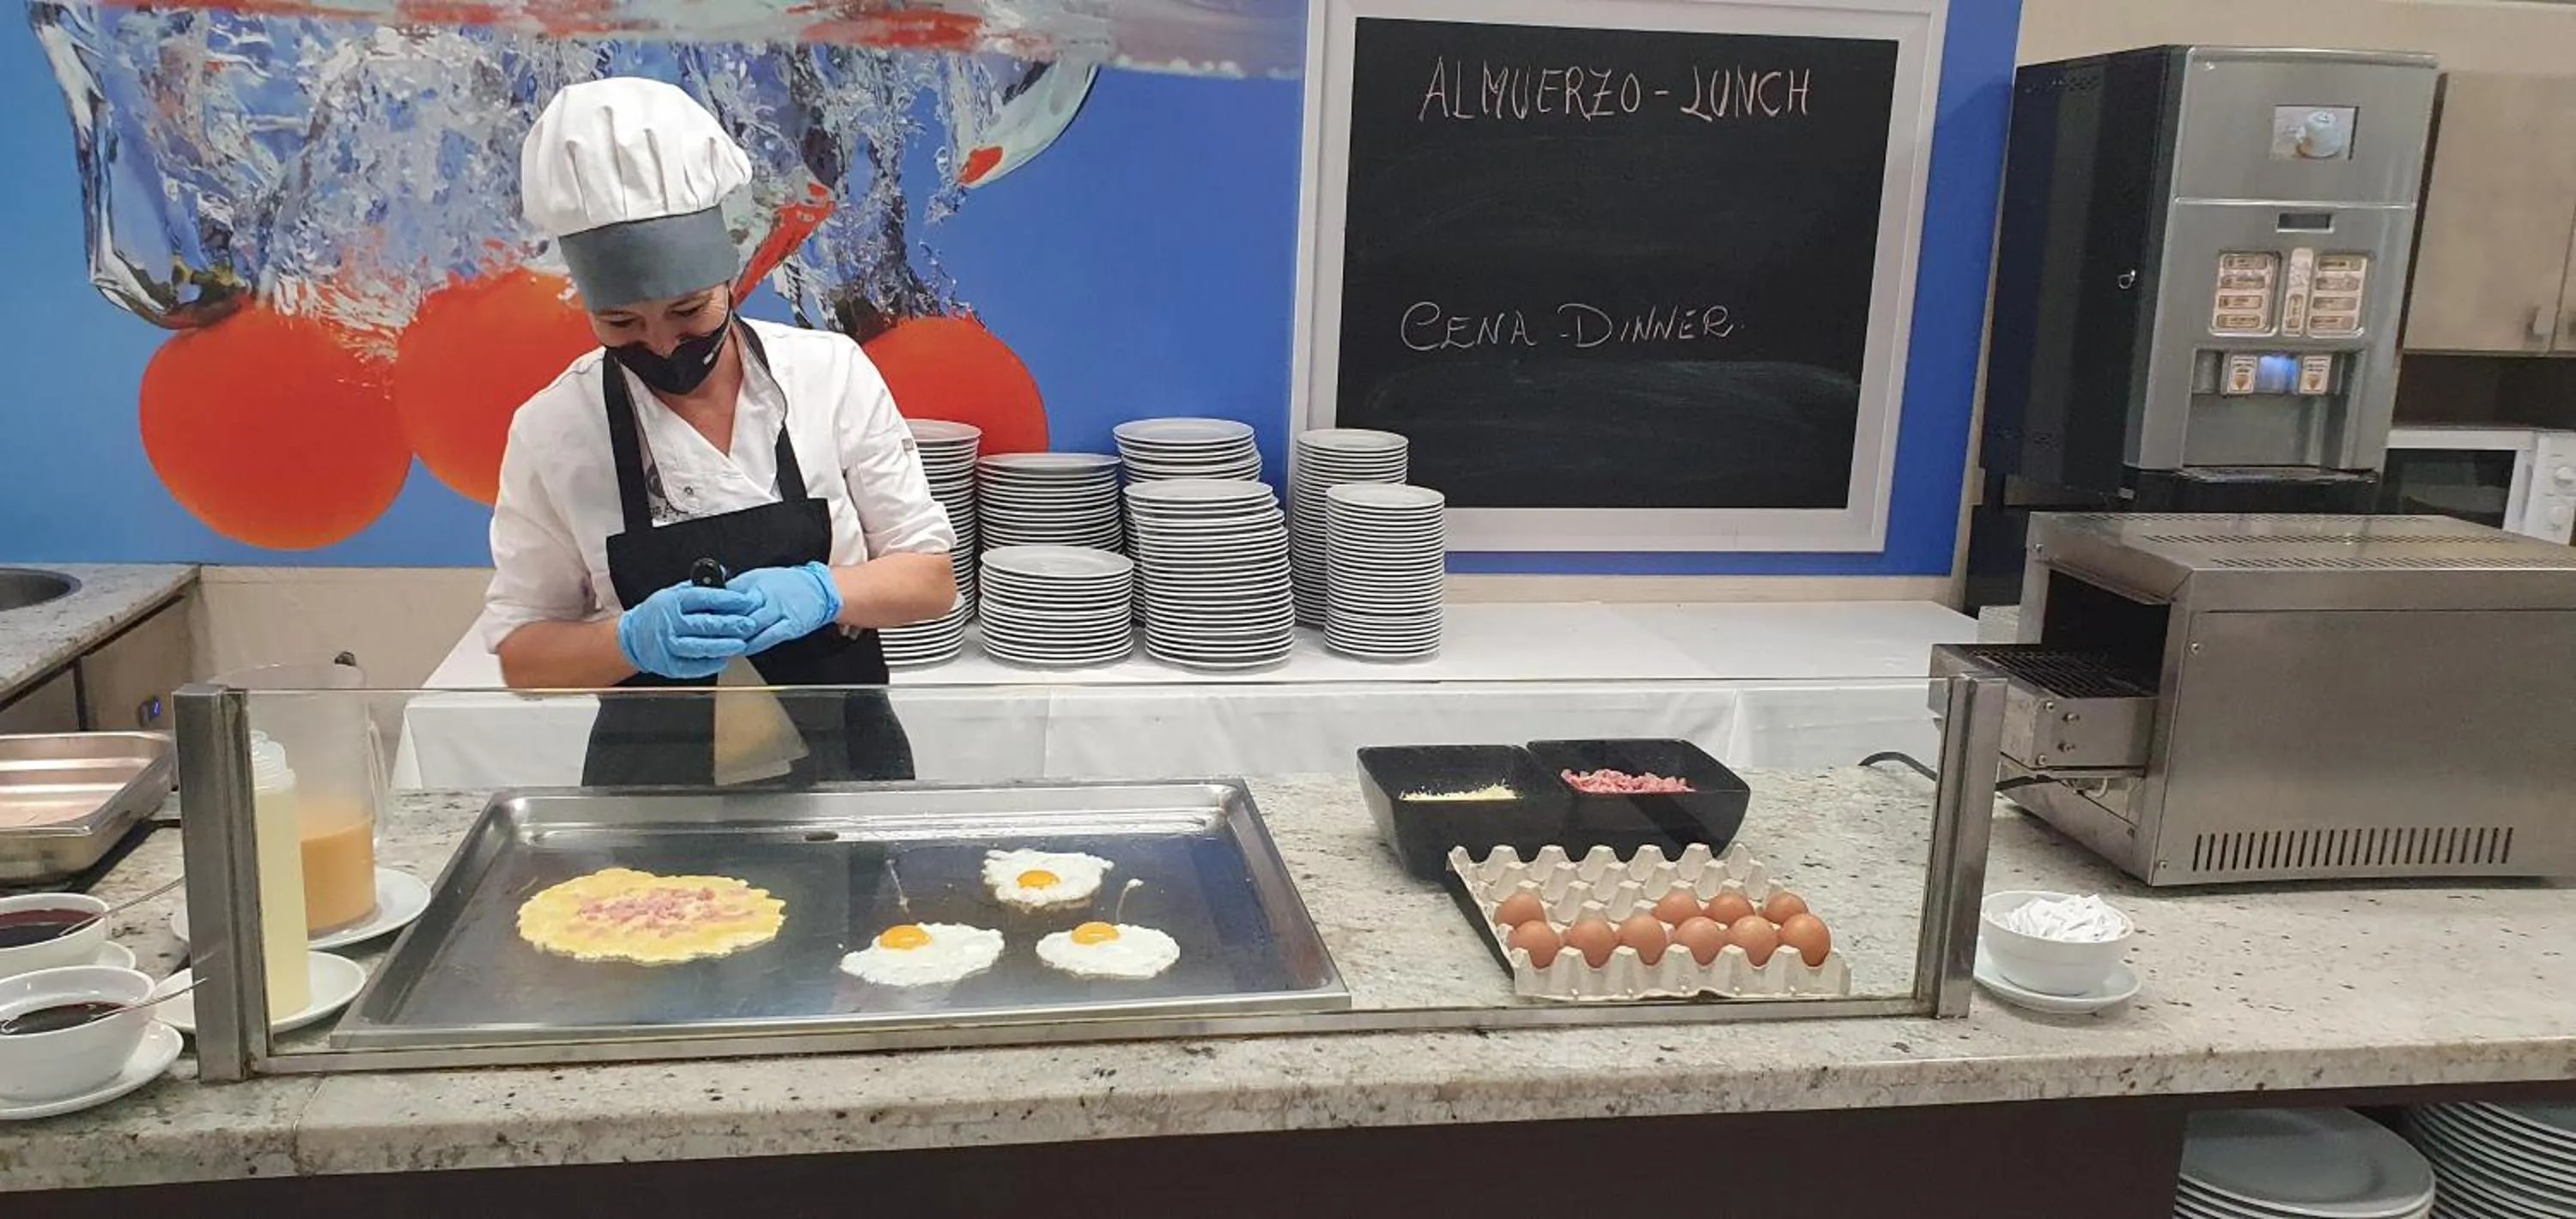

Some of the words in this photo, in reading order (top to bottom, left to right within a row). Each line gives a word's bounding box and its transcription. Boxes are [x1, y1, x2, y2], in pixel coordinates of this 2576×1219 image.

[1418, 56, 1641, 122] ALMUERZO
[1679, 64, 1811, 123] LUNCH
[1400, 300, 1537, 351] CENA
